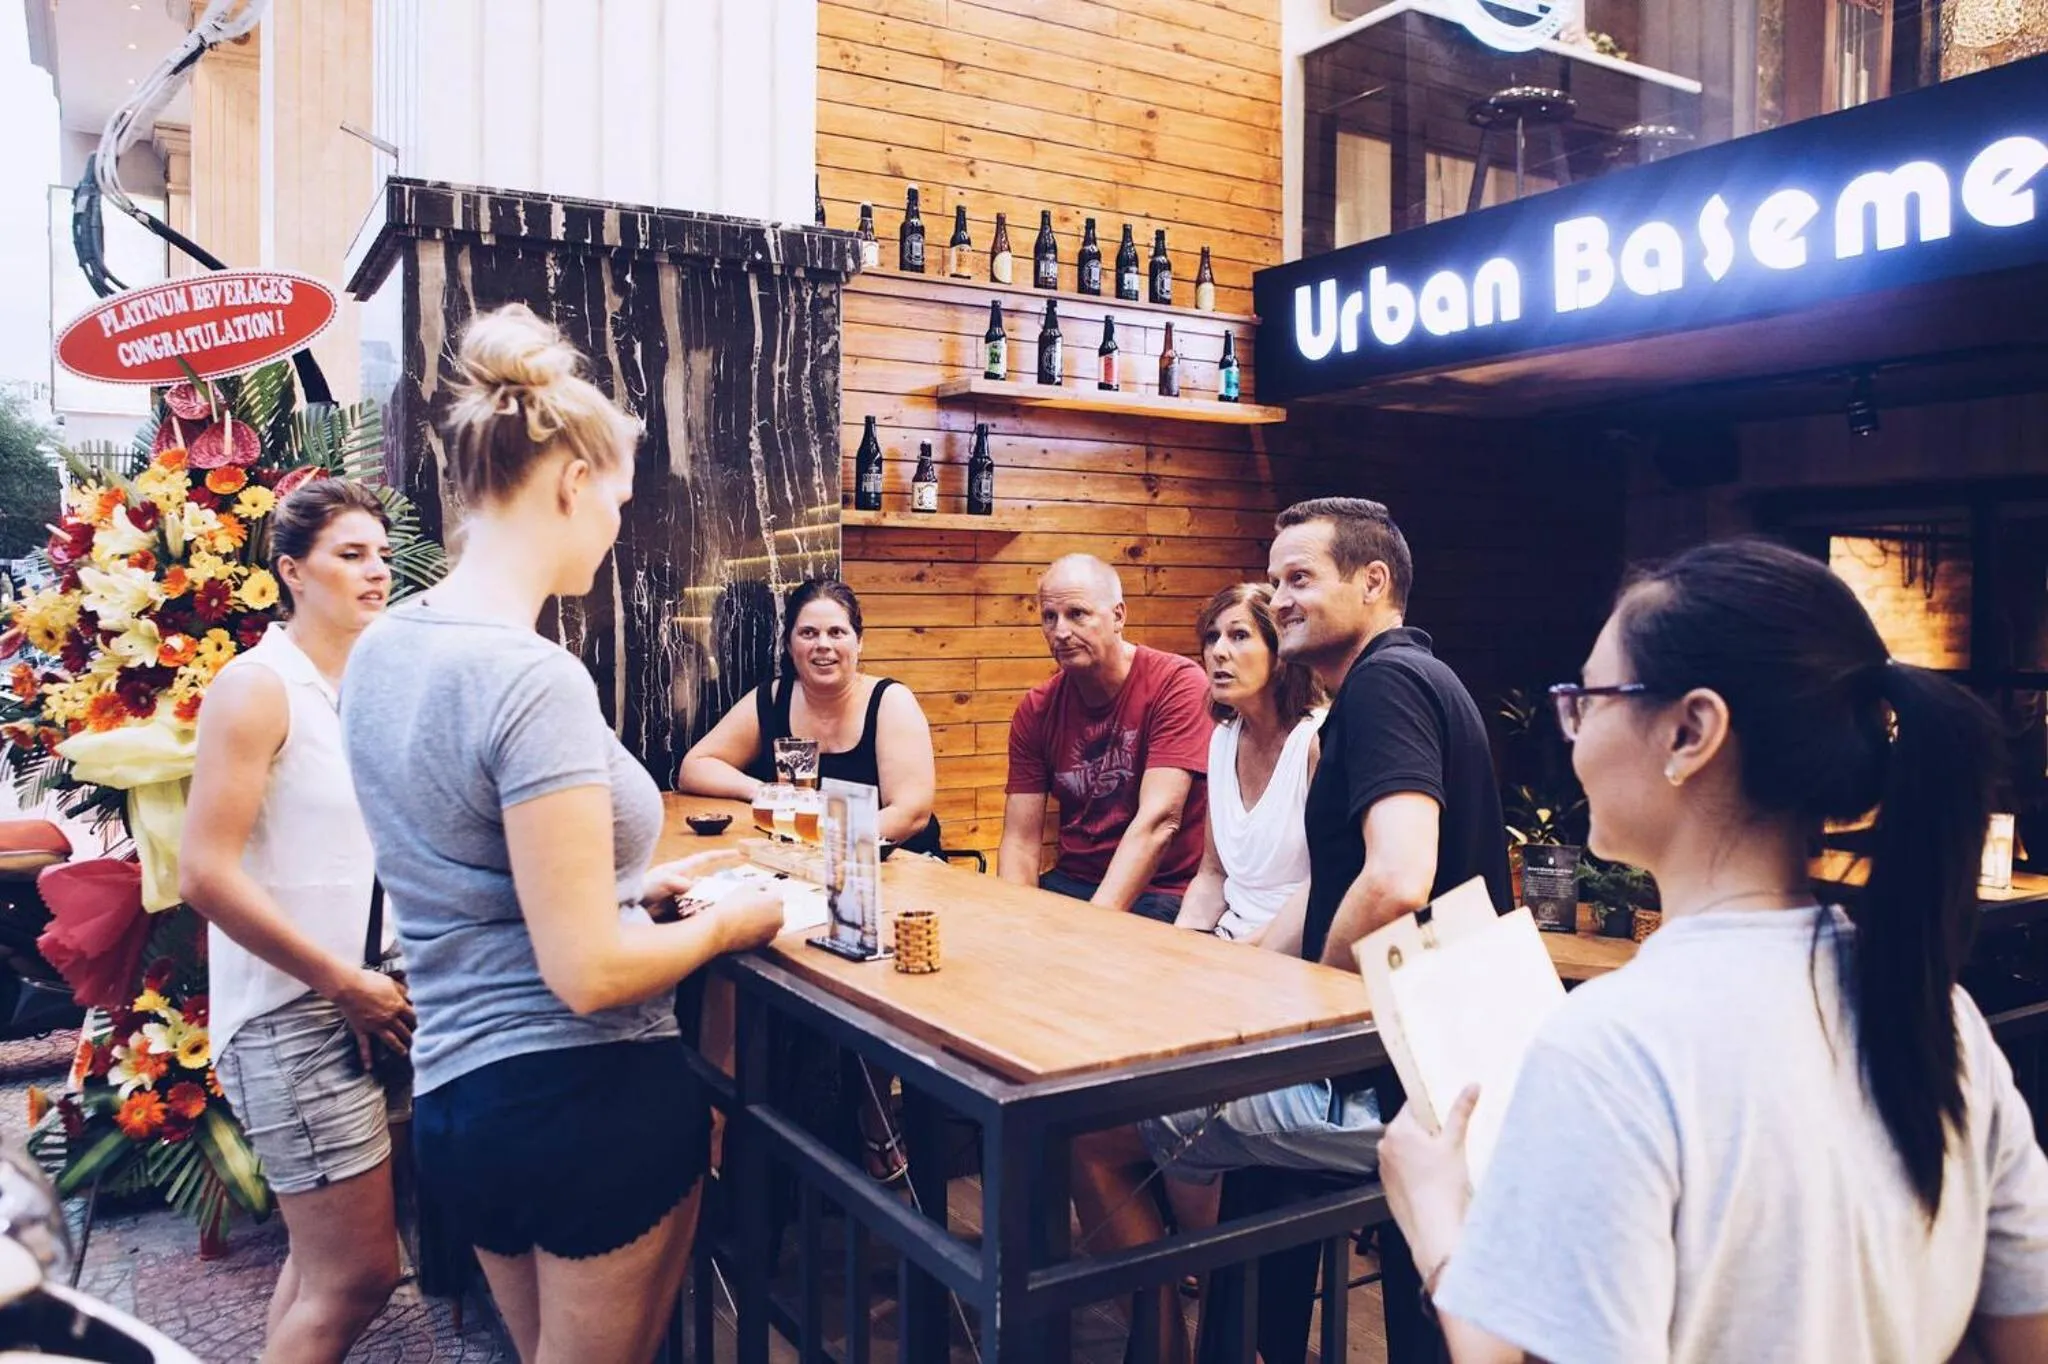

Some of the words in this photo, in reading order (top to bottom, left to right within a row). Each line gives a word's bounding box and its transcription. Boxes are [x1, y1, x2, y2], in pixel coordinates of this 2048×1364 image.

[98, 287, 190, 337] PLATINUM
[192, 278, 294, 310] BEVERAGES
[1295, 257, 1521, 360] Urban
[1553, 136, 2048, 313] Baseme
